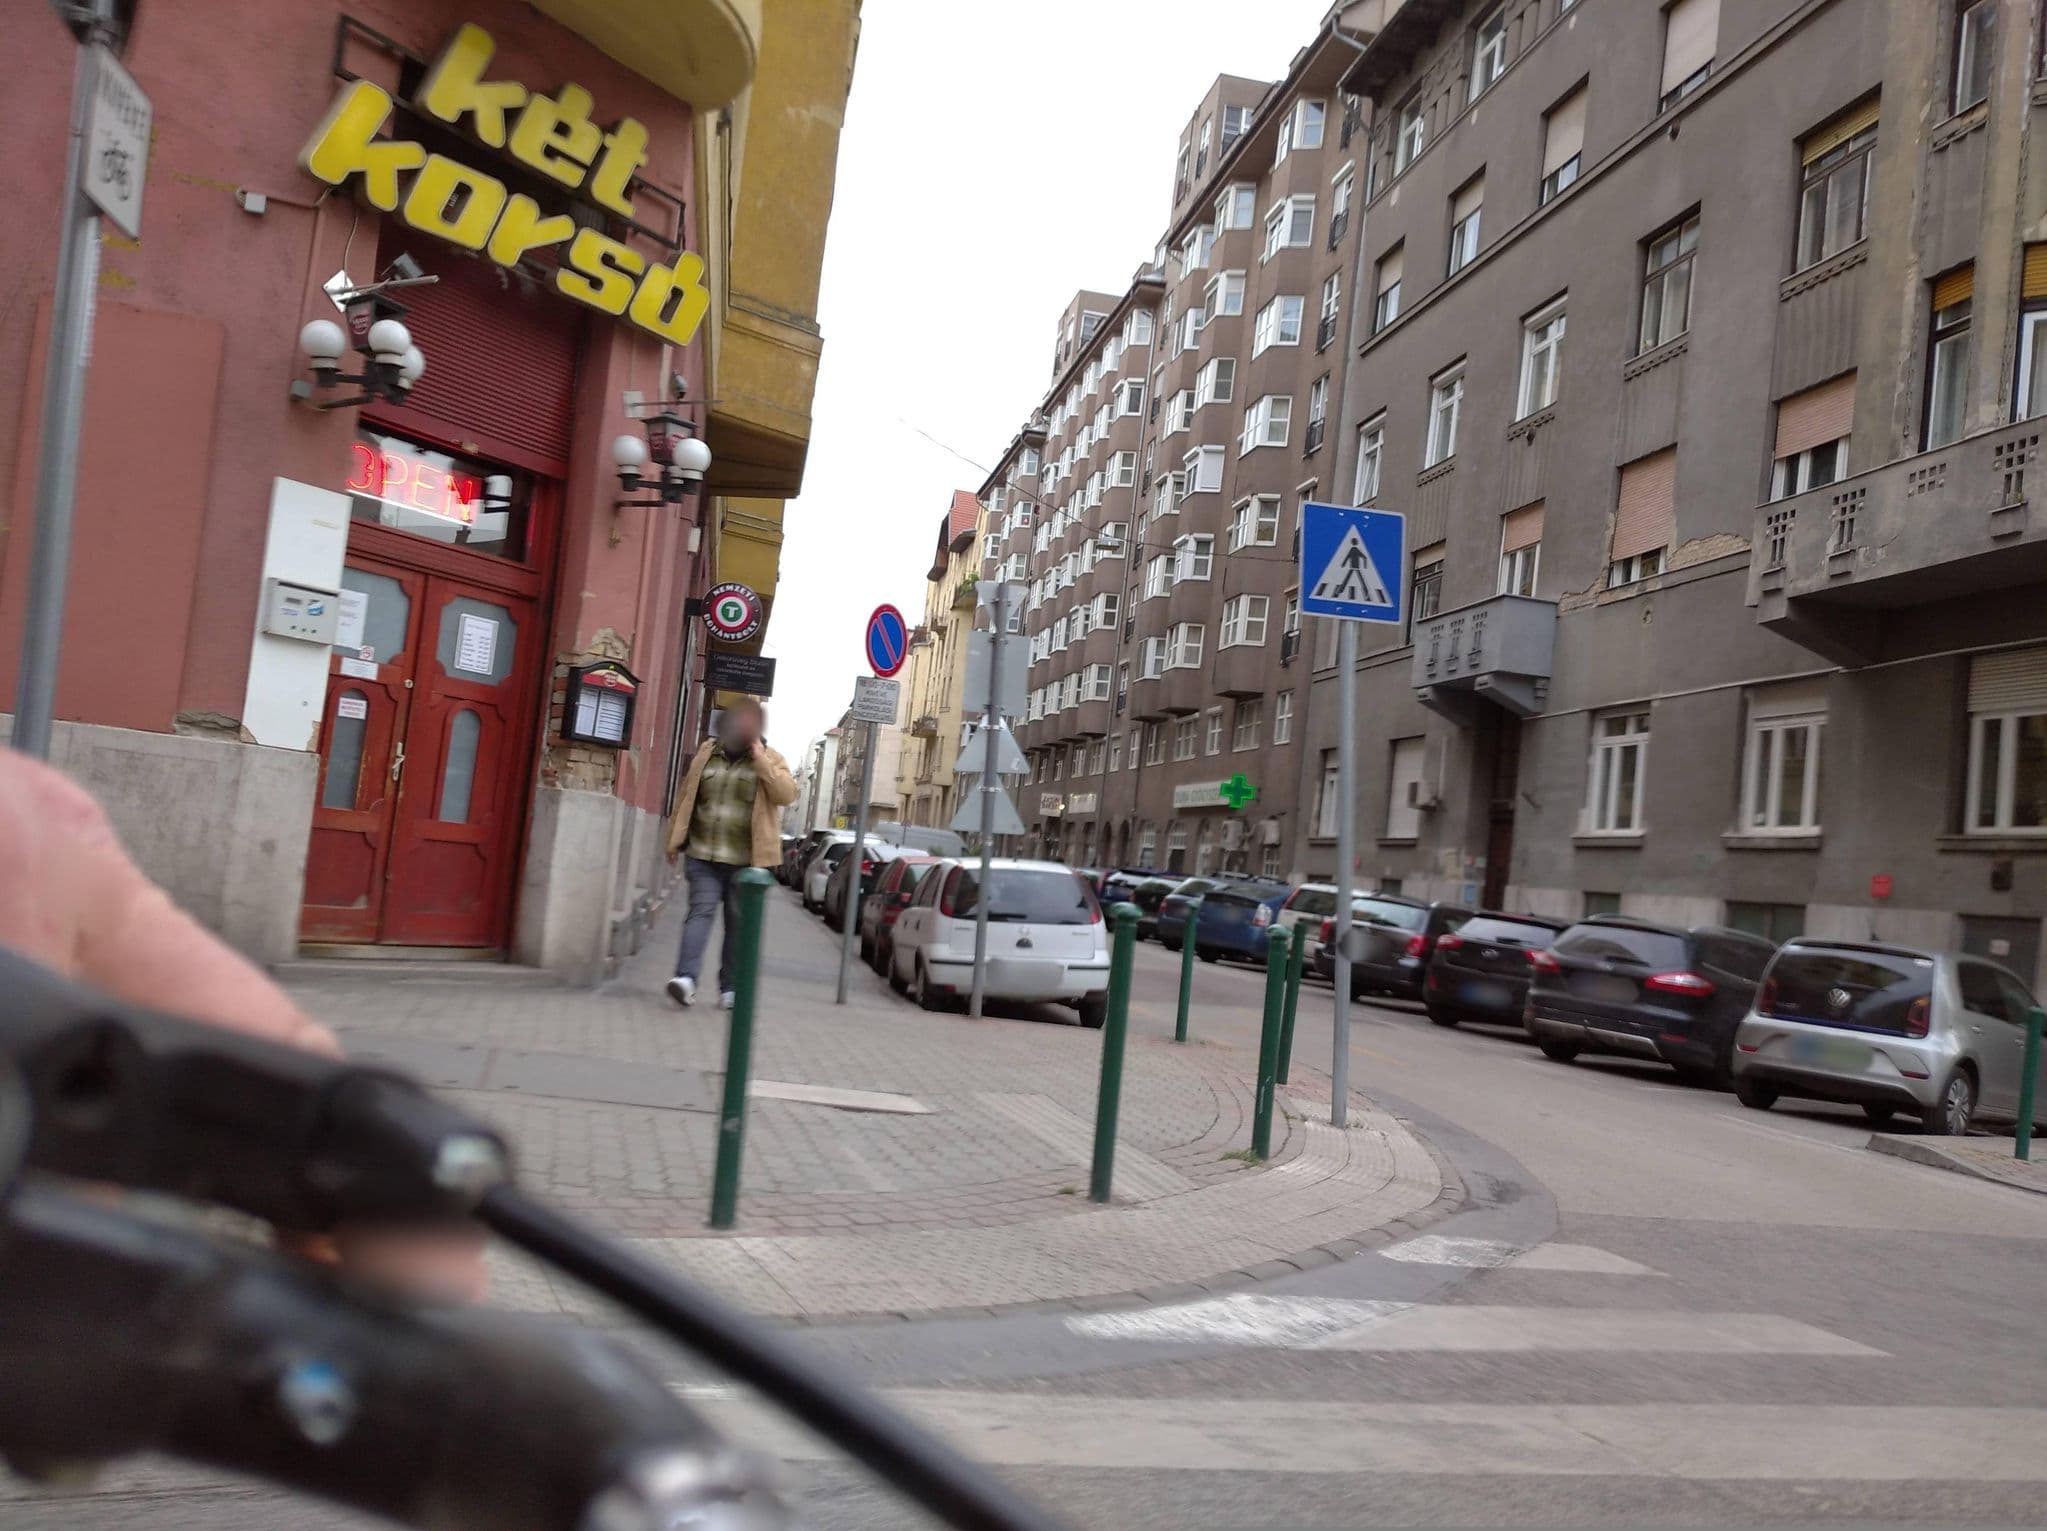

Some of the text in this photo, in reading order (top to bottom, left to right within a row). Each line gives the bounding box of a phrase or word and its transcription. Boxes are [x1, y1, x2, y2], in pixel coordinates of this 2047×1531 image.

[424, 23, 650, 218] két
[303, 80, 710, 346] korsó
[349, 444, 474, 522] OPEN
[712, 584, 756, 602] NEMZETI
[726, 606, 739, 618] T
